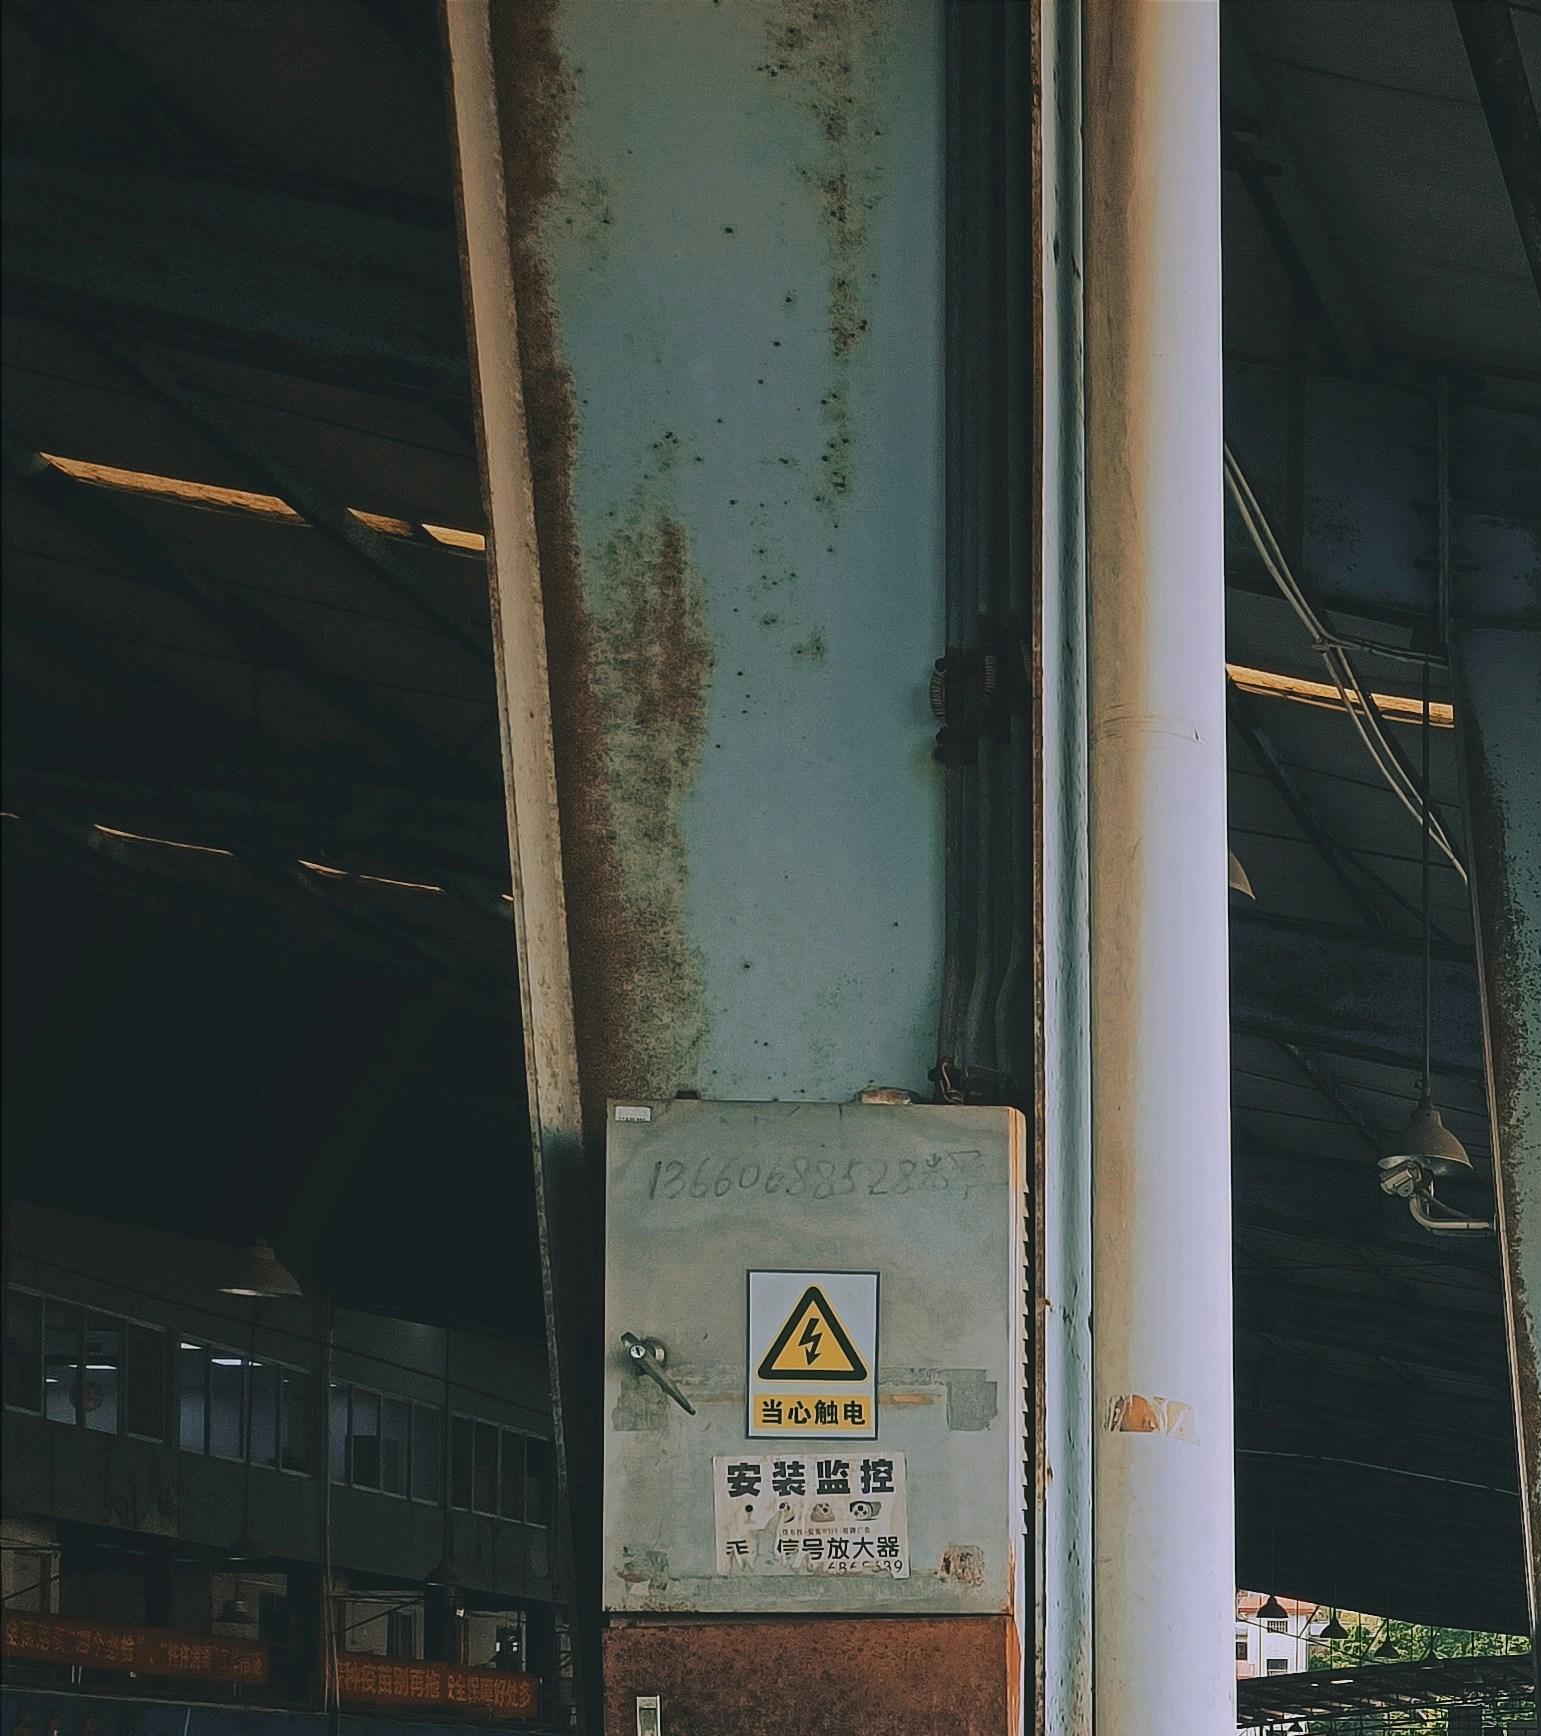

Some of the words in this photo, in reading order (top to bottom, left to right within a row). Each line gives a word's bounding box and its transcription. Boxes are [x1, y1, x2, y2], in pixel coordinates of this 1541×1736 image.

[760, 1398, 866, 1427] 当心触电
[726, 1458, 895, 1498] 安装监控
